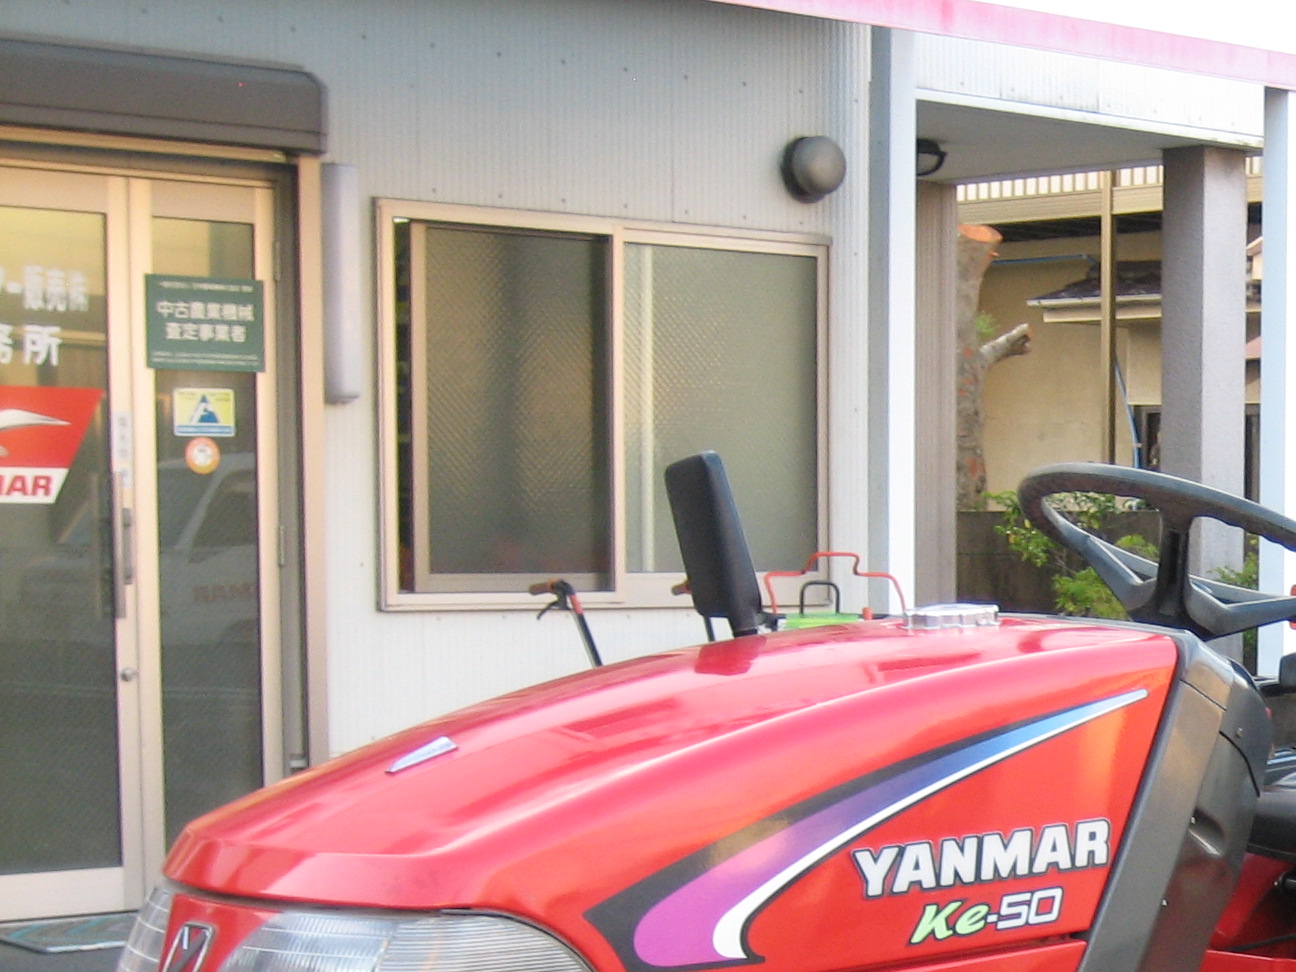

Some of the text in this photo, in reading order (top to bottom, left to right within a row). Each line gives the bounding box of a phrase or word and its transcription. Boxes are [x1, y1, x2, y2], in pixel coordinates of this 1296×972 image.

[0, 475, 52, 497] AR
[853, 818, 1110, 897] YANMAR
[909, 886, 1065, 945] Ke-50
